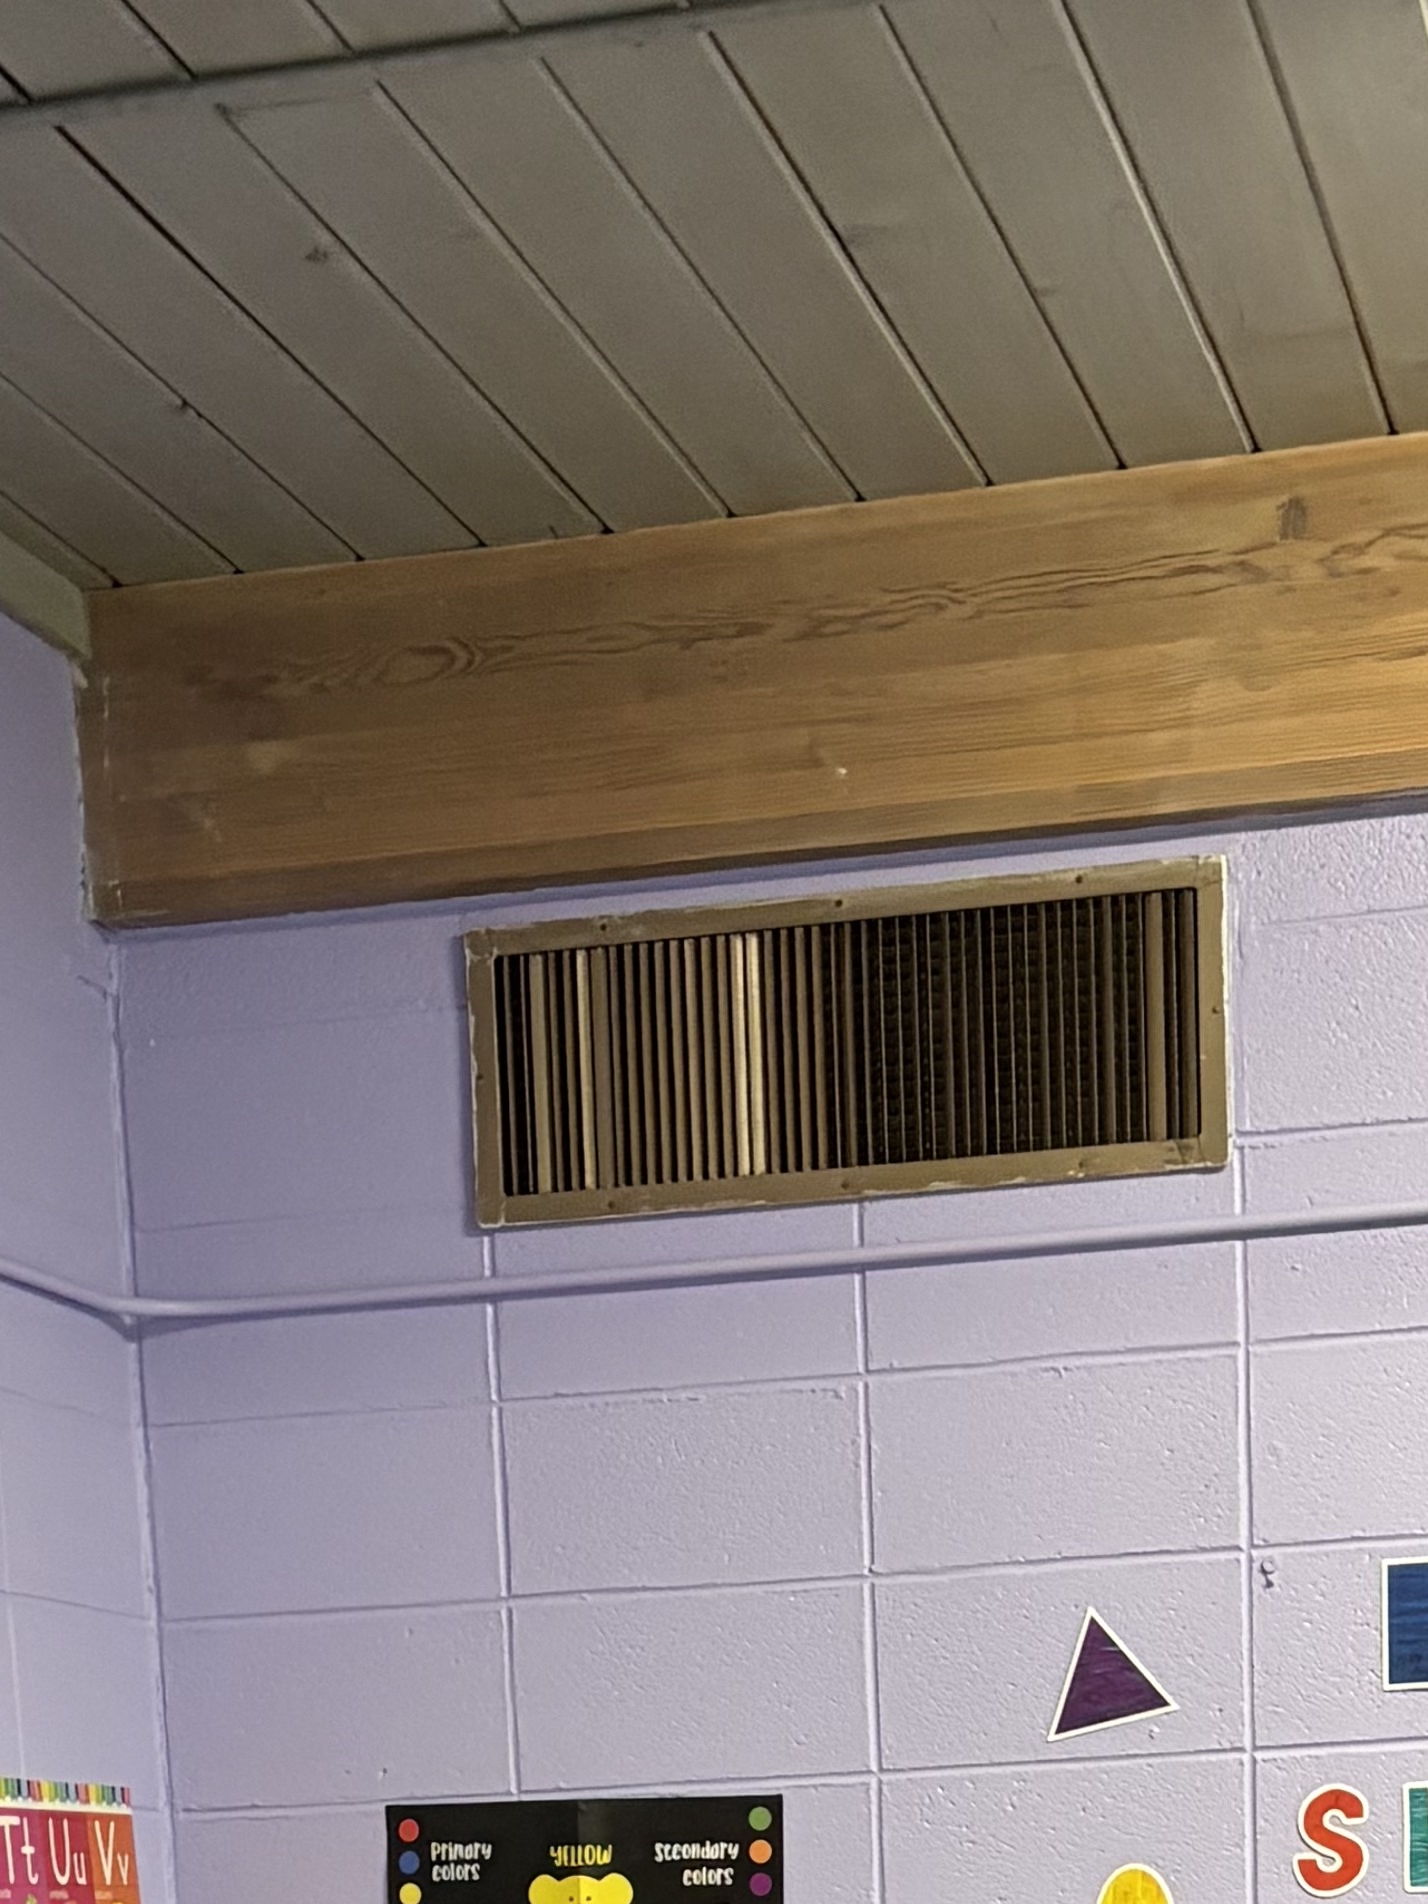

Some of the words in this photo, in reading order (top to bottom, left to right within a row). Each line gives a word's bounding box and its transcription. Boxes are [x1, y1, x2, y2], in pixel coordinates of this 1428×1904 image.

[48, 1816, 88, 1886] Uu
[94, 1818, 129, 1887] Vv
[549, 1844, 613, 1867] YELLOW
[432, 1862, 480, 1882] colors
[682, 1866, 735, 1887] colors
